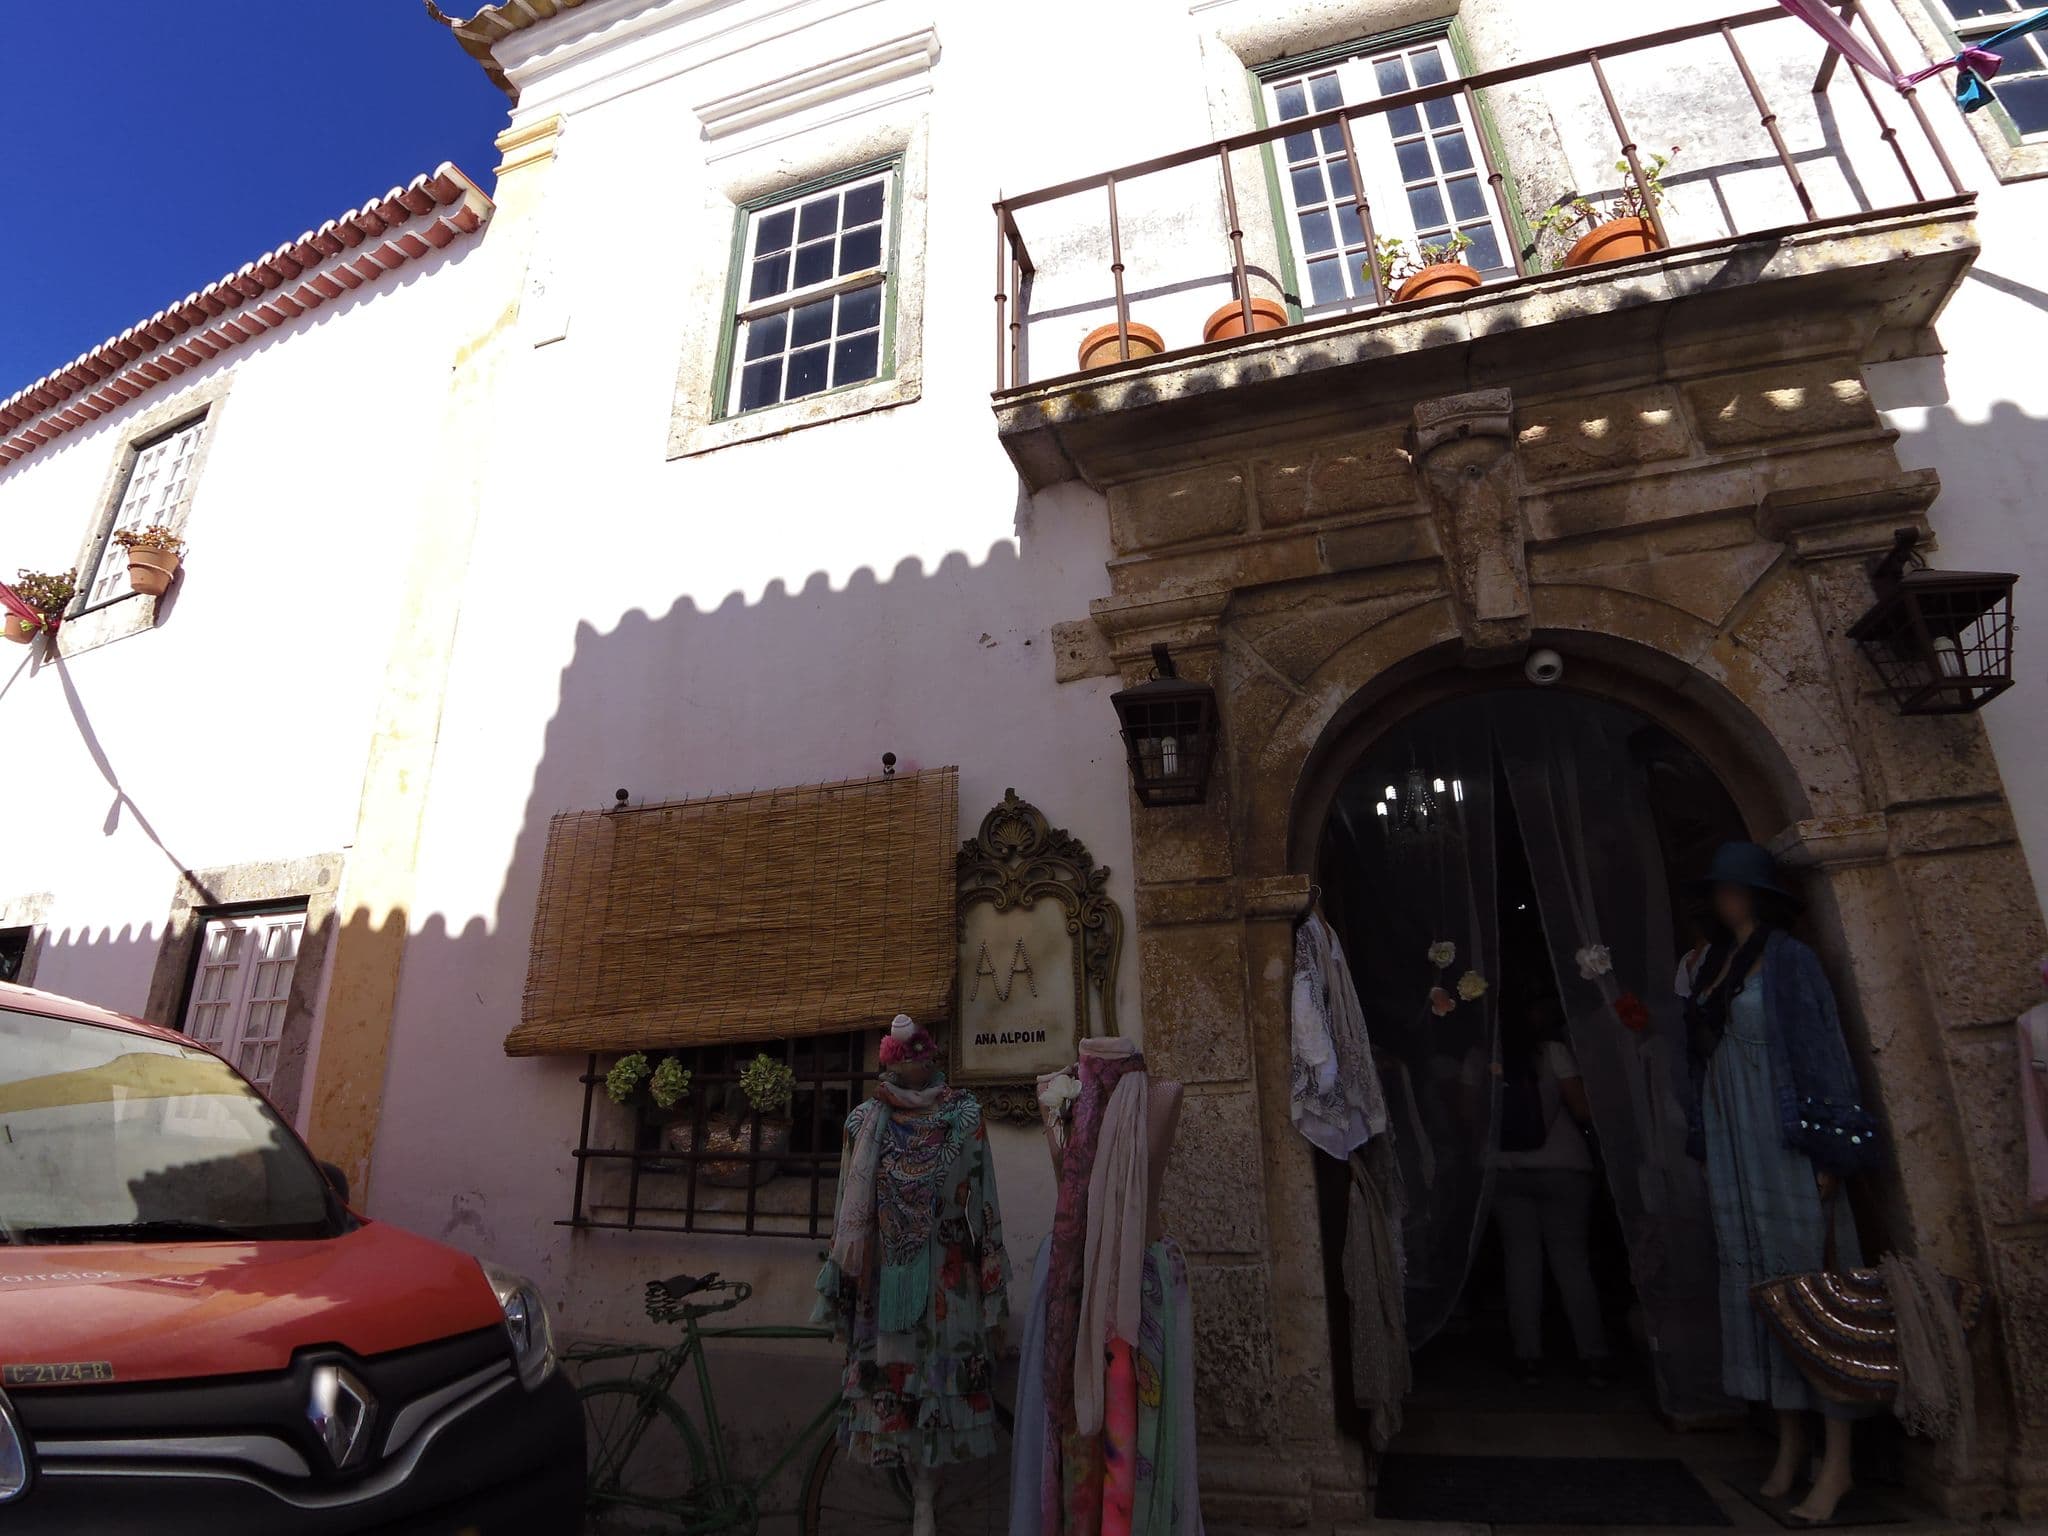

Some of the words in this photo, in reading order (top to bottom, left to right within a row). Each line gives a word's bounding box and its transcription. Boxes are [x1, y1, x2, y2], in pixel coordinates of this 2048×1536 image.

[975, 1033, 998, 1045] ANA
[1000, 1030, 1046, 1044] ALPOIM
[0, 1271, 120, 1283] orreios
